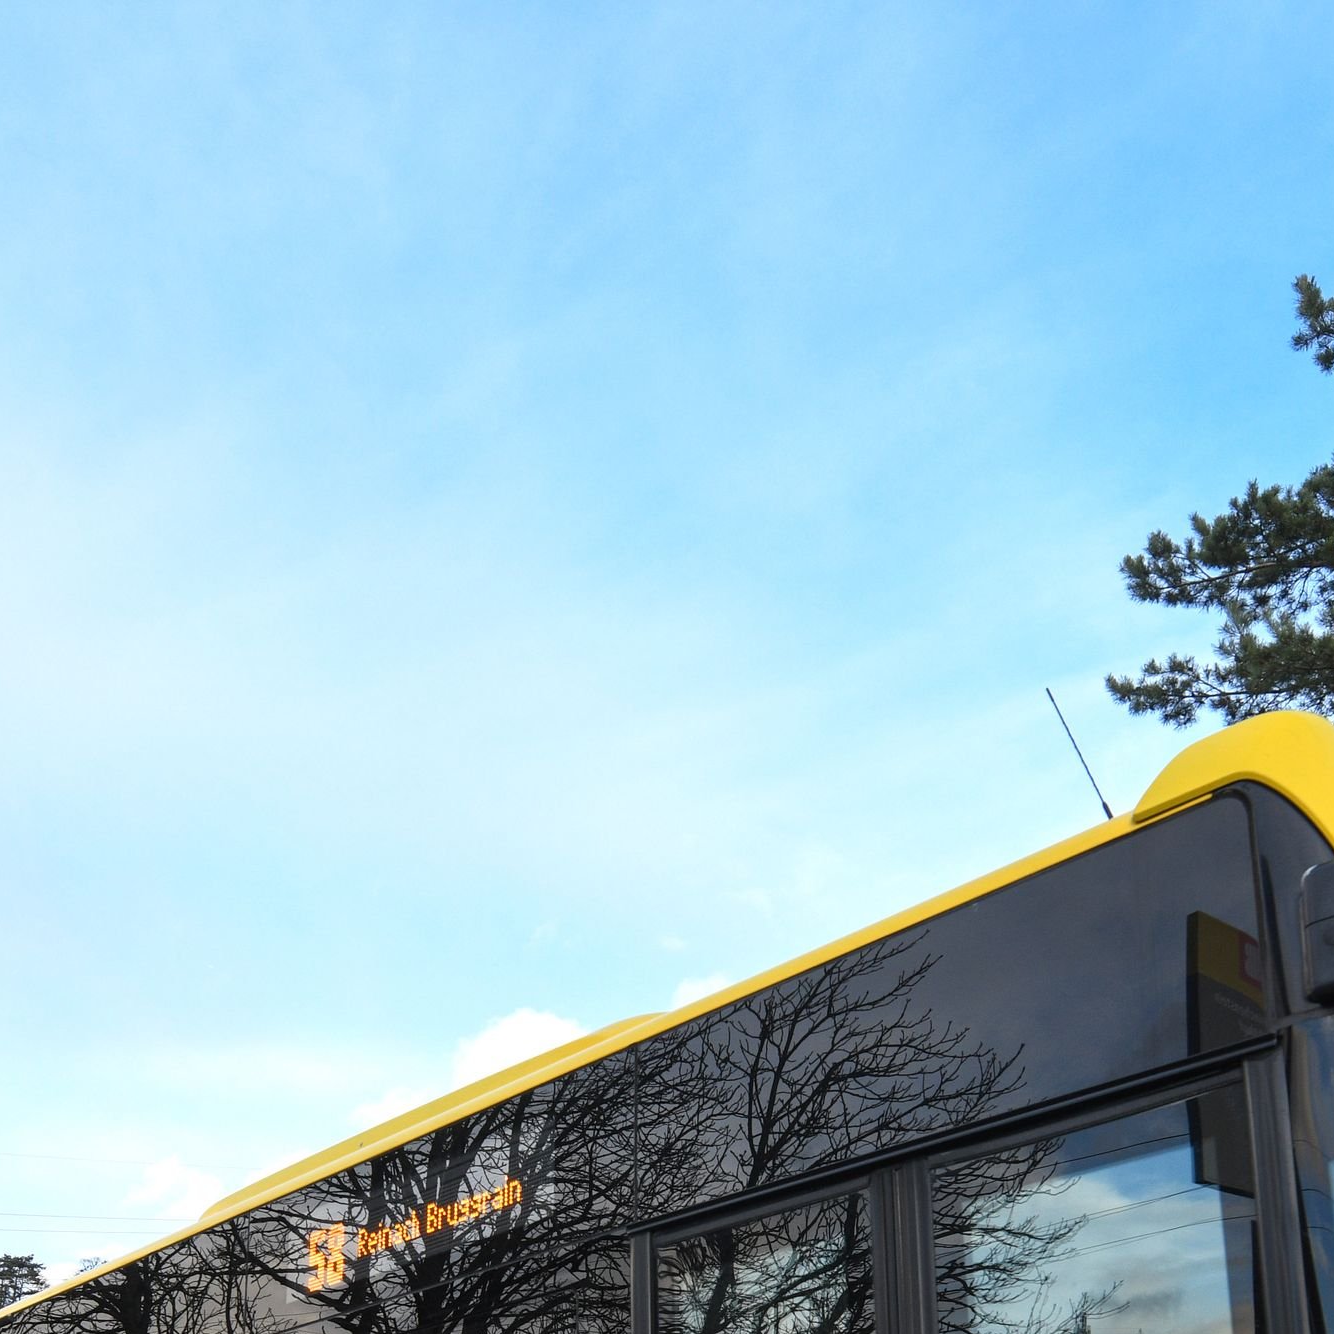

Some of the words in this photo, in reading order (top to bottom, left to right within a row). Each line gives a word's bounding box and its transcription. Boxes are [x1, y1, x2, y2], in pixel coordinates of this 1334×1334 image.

[308, 1222, 345, 1293] 58
[357, 1208, 421, 1258] Reinach
[425, 1174, 523, 1235] Bruggrain
